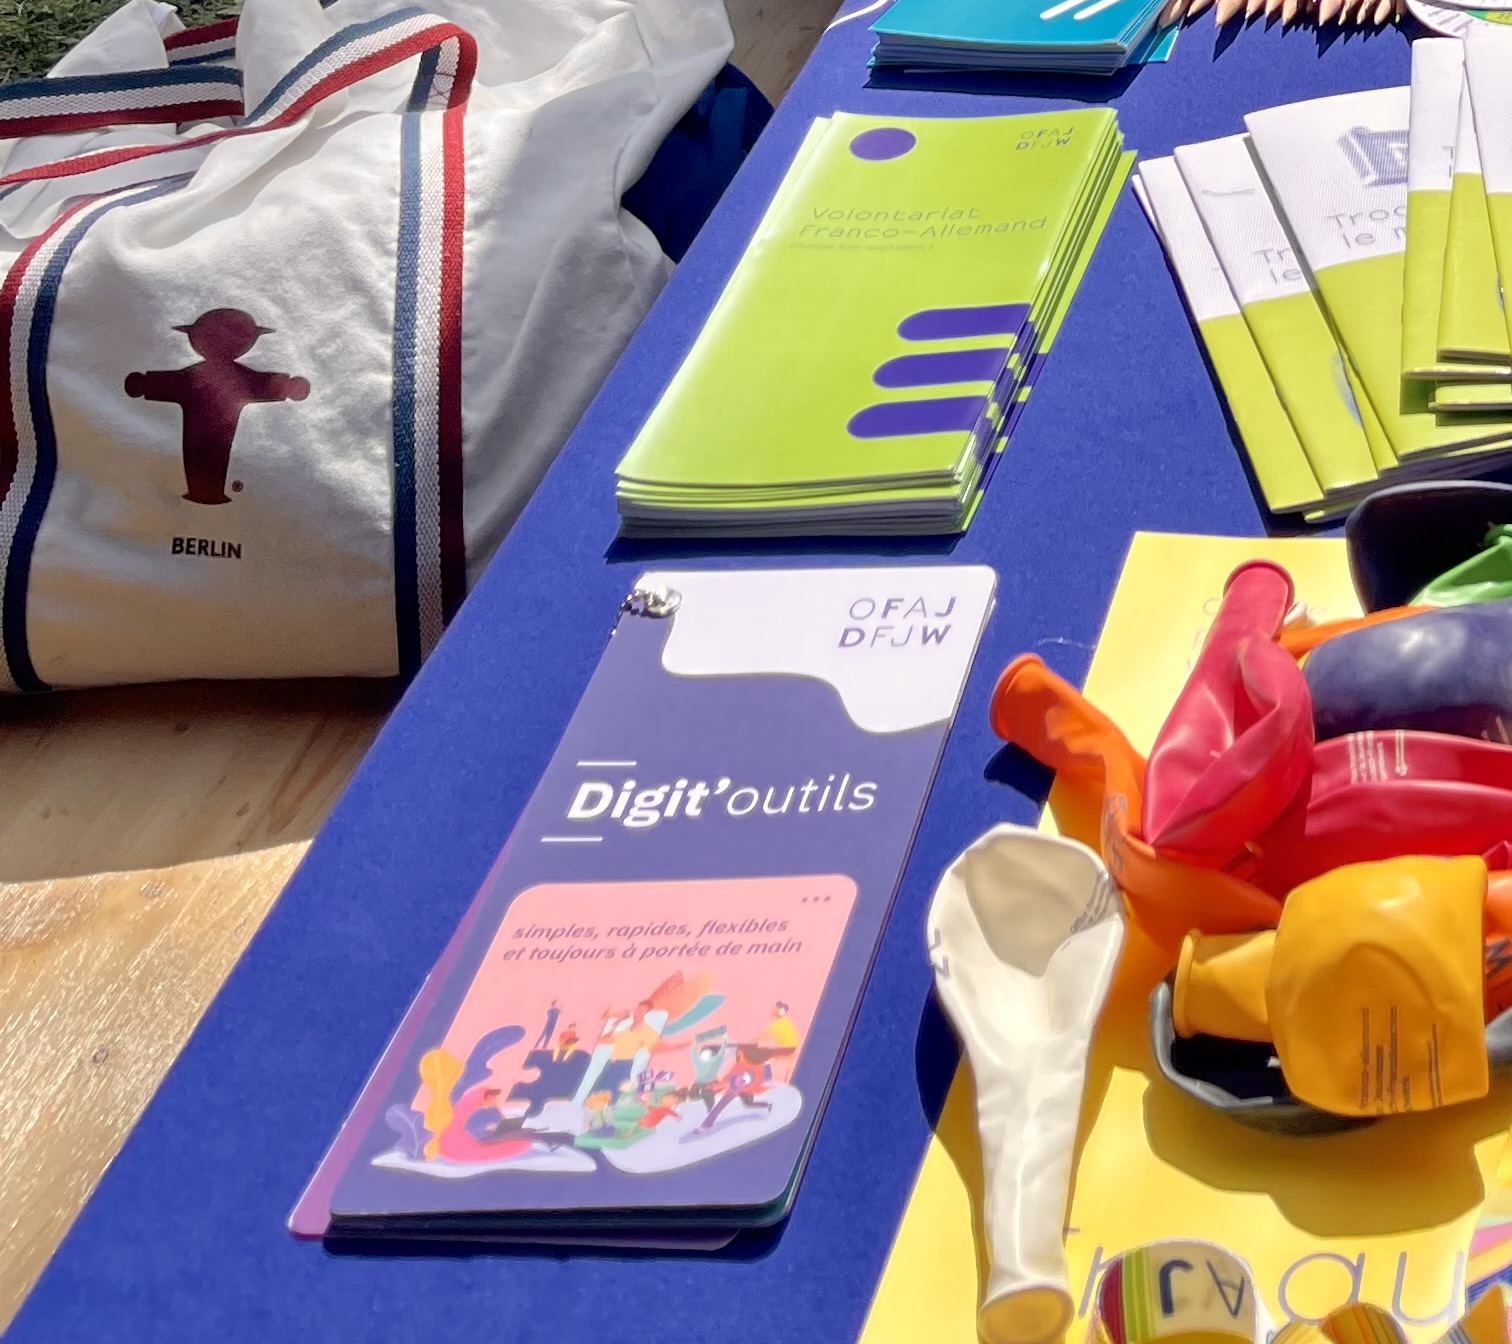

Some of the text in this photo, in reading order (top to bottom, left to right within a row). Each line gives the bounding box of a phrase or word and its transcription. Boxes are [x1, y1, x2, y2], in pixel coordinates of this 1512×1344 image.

[1020, 126, 1075, 141] OFAJ
[813, 206, 981, 222] Volontariat
[1327, 205, 1407, 228] Tro
[798, 216, 1048, 239] Franco-Allemand
[1342, 232, 1376, 248] le
[171, 536, 242, 560] BERLIN
[849, 596, 957, 621] OFAJ
[838, 624, 951, 648] DFJW
[566, 772, 878, 829] Digit'outils
[512, 918, 790, 942] simples, rapides, flexibles
[502, 939, 803, 963] et toujours à portée de main
